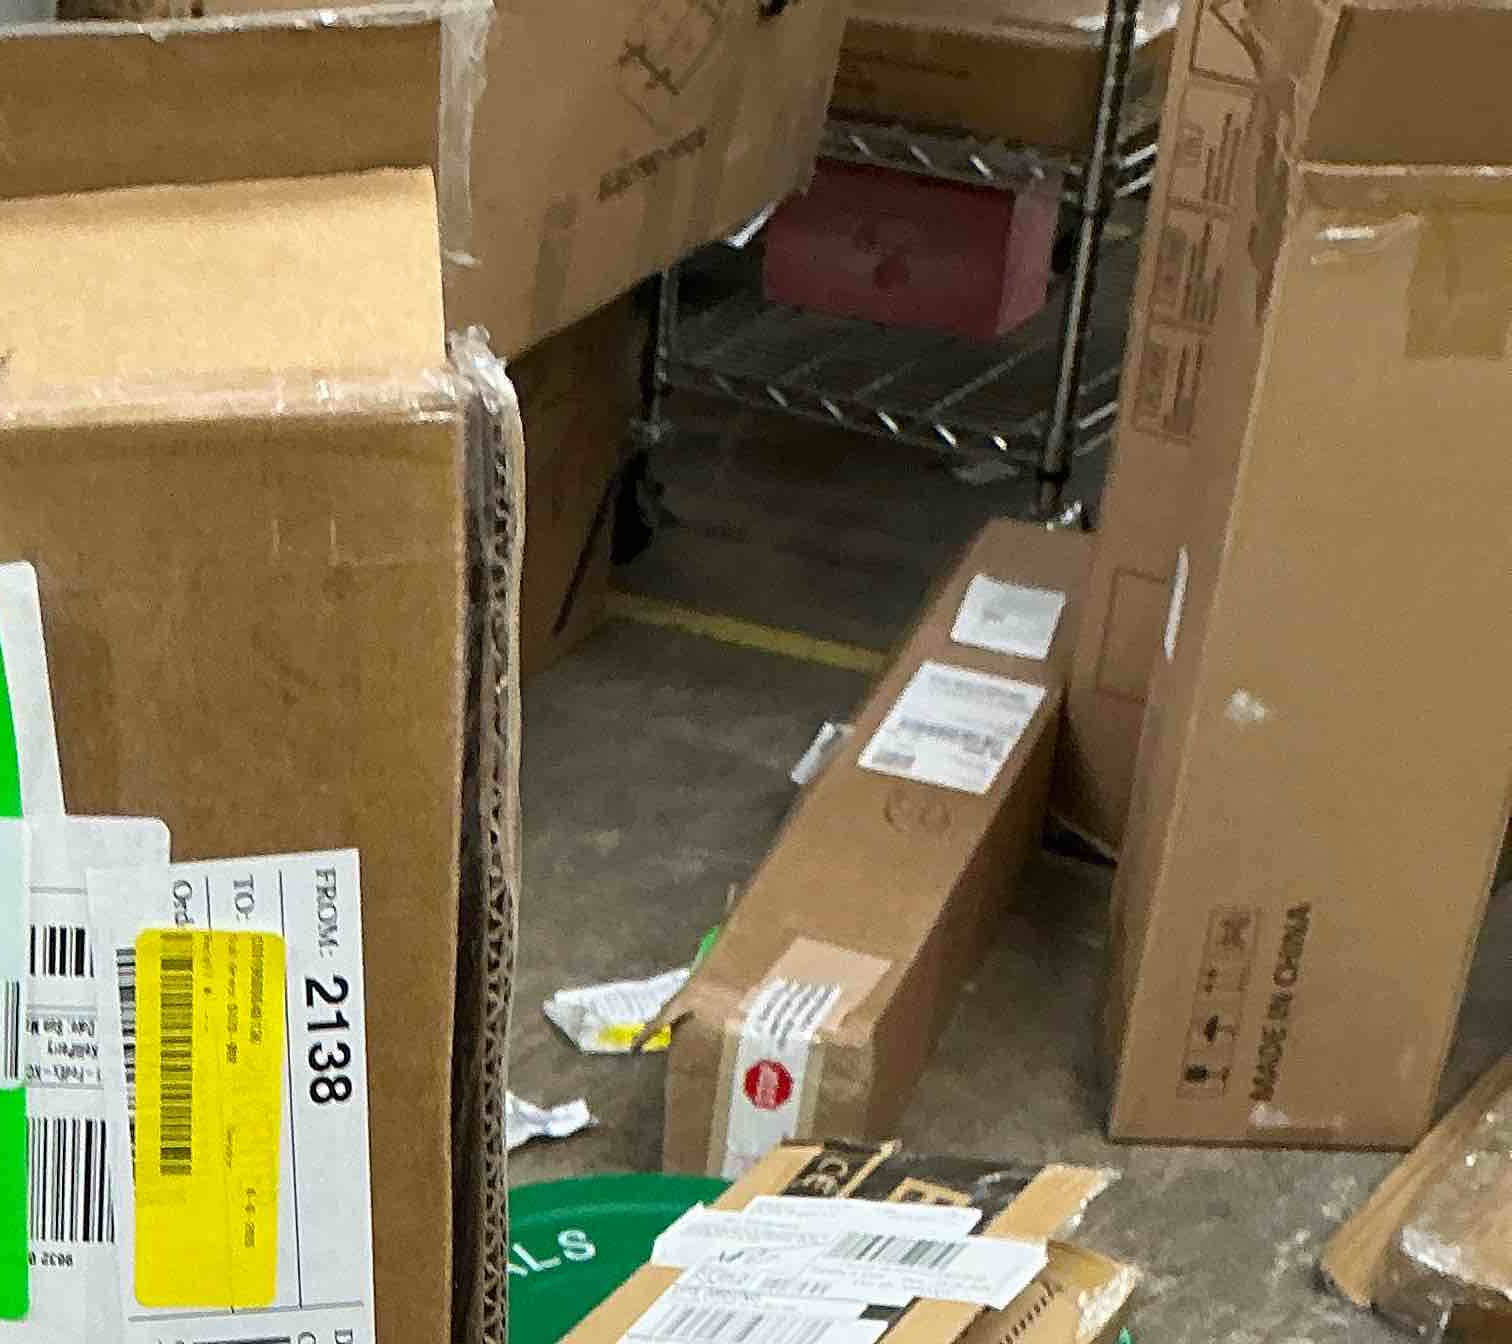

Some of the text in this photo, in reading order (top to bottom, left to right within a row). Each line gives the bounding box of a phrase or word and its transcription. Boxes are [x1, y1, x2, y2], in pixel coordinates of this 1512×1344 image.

[232, 874, 256, 921] TO:
[304, 866, 353, 1105] FROM: 2138
